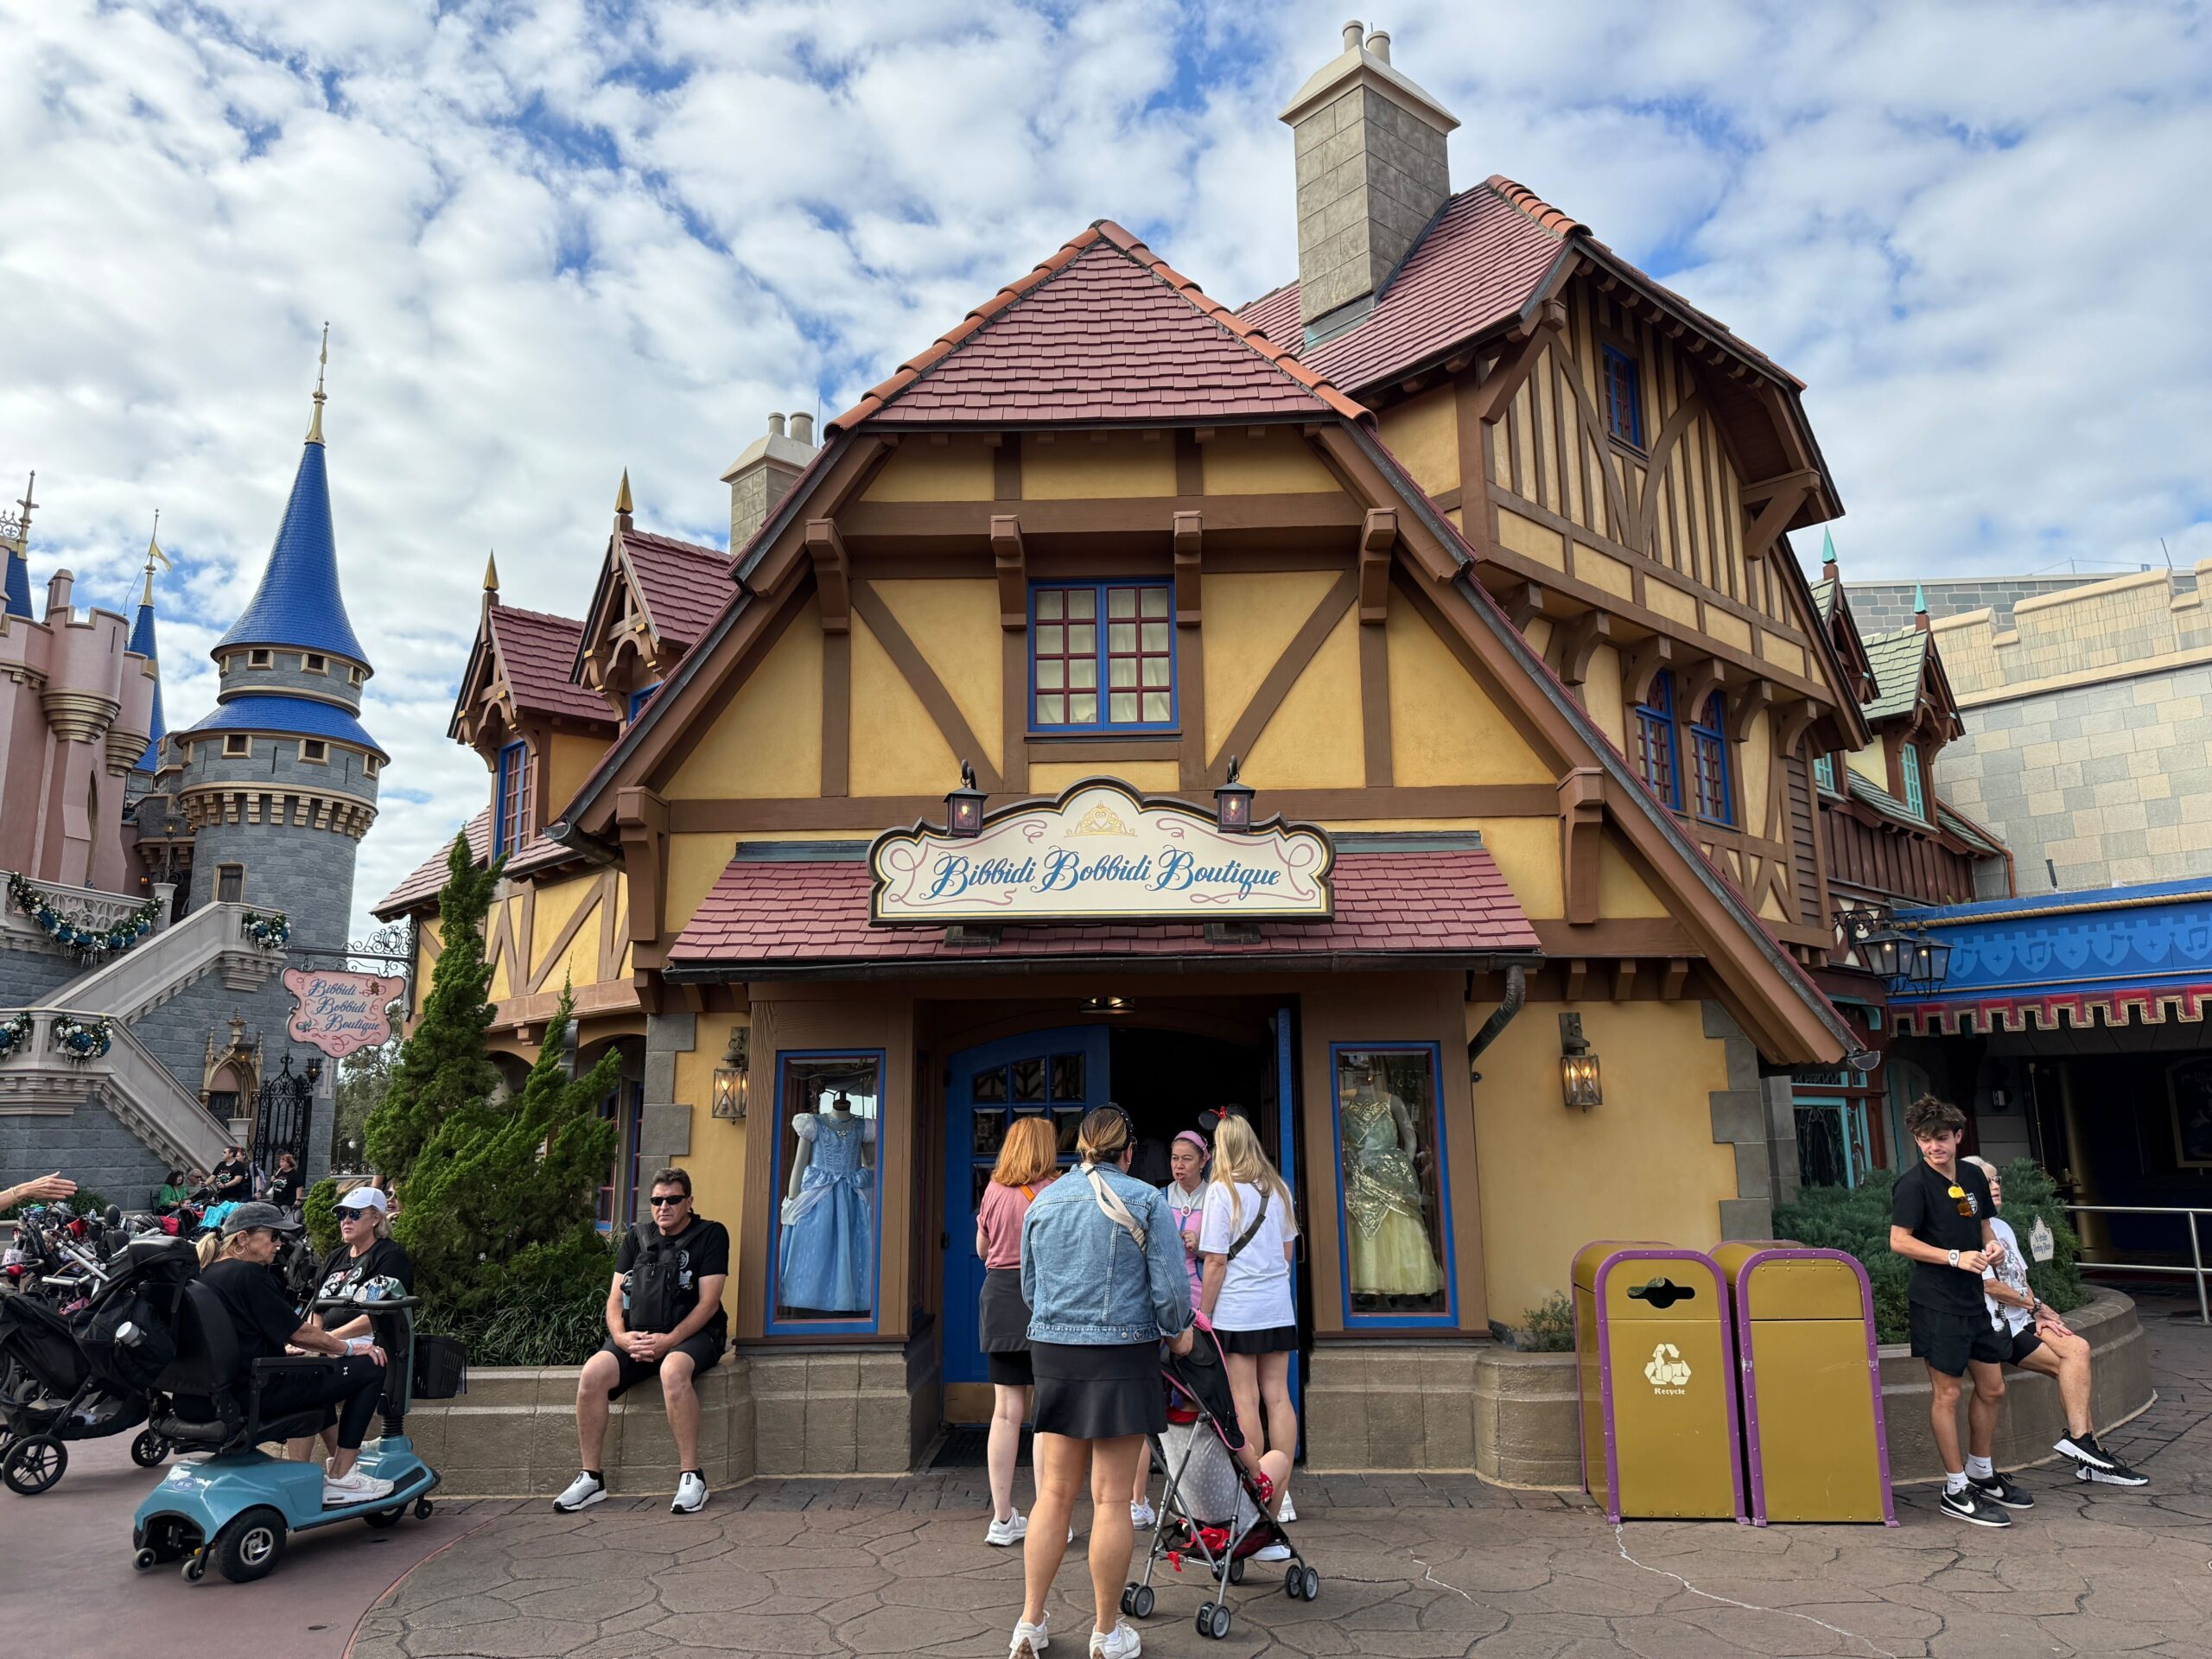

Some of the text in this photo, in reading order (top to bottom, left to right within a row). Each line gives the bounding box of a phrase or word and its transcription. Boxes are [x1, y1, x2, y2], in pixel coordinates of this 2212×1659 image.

[919, 844, 1281, 900] Bibbidi Bobbidi Boutique
[303, 978, 357, 997] Bibbidi
[311, 996, 367, 1014] Bobbidi
[321, 1014, 380, 1036] Boutique
[1654, 1388, 1686, 1396] Recycle
